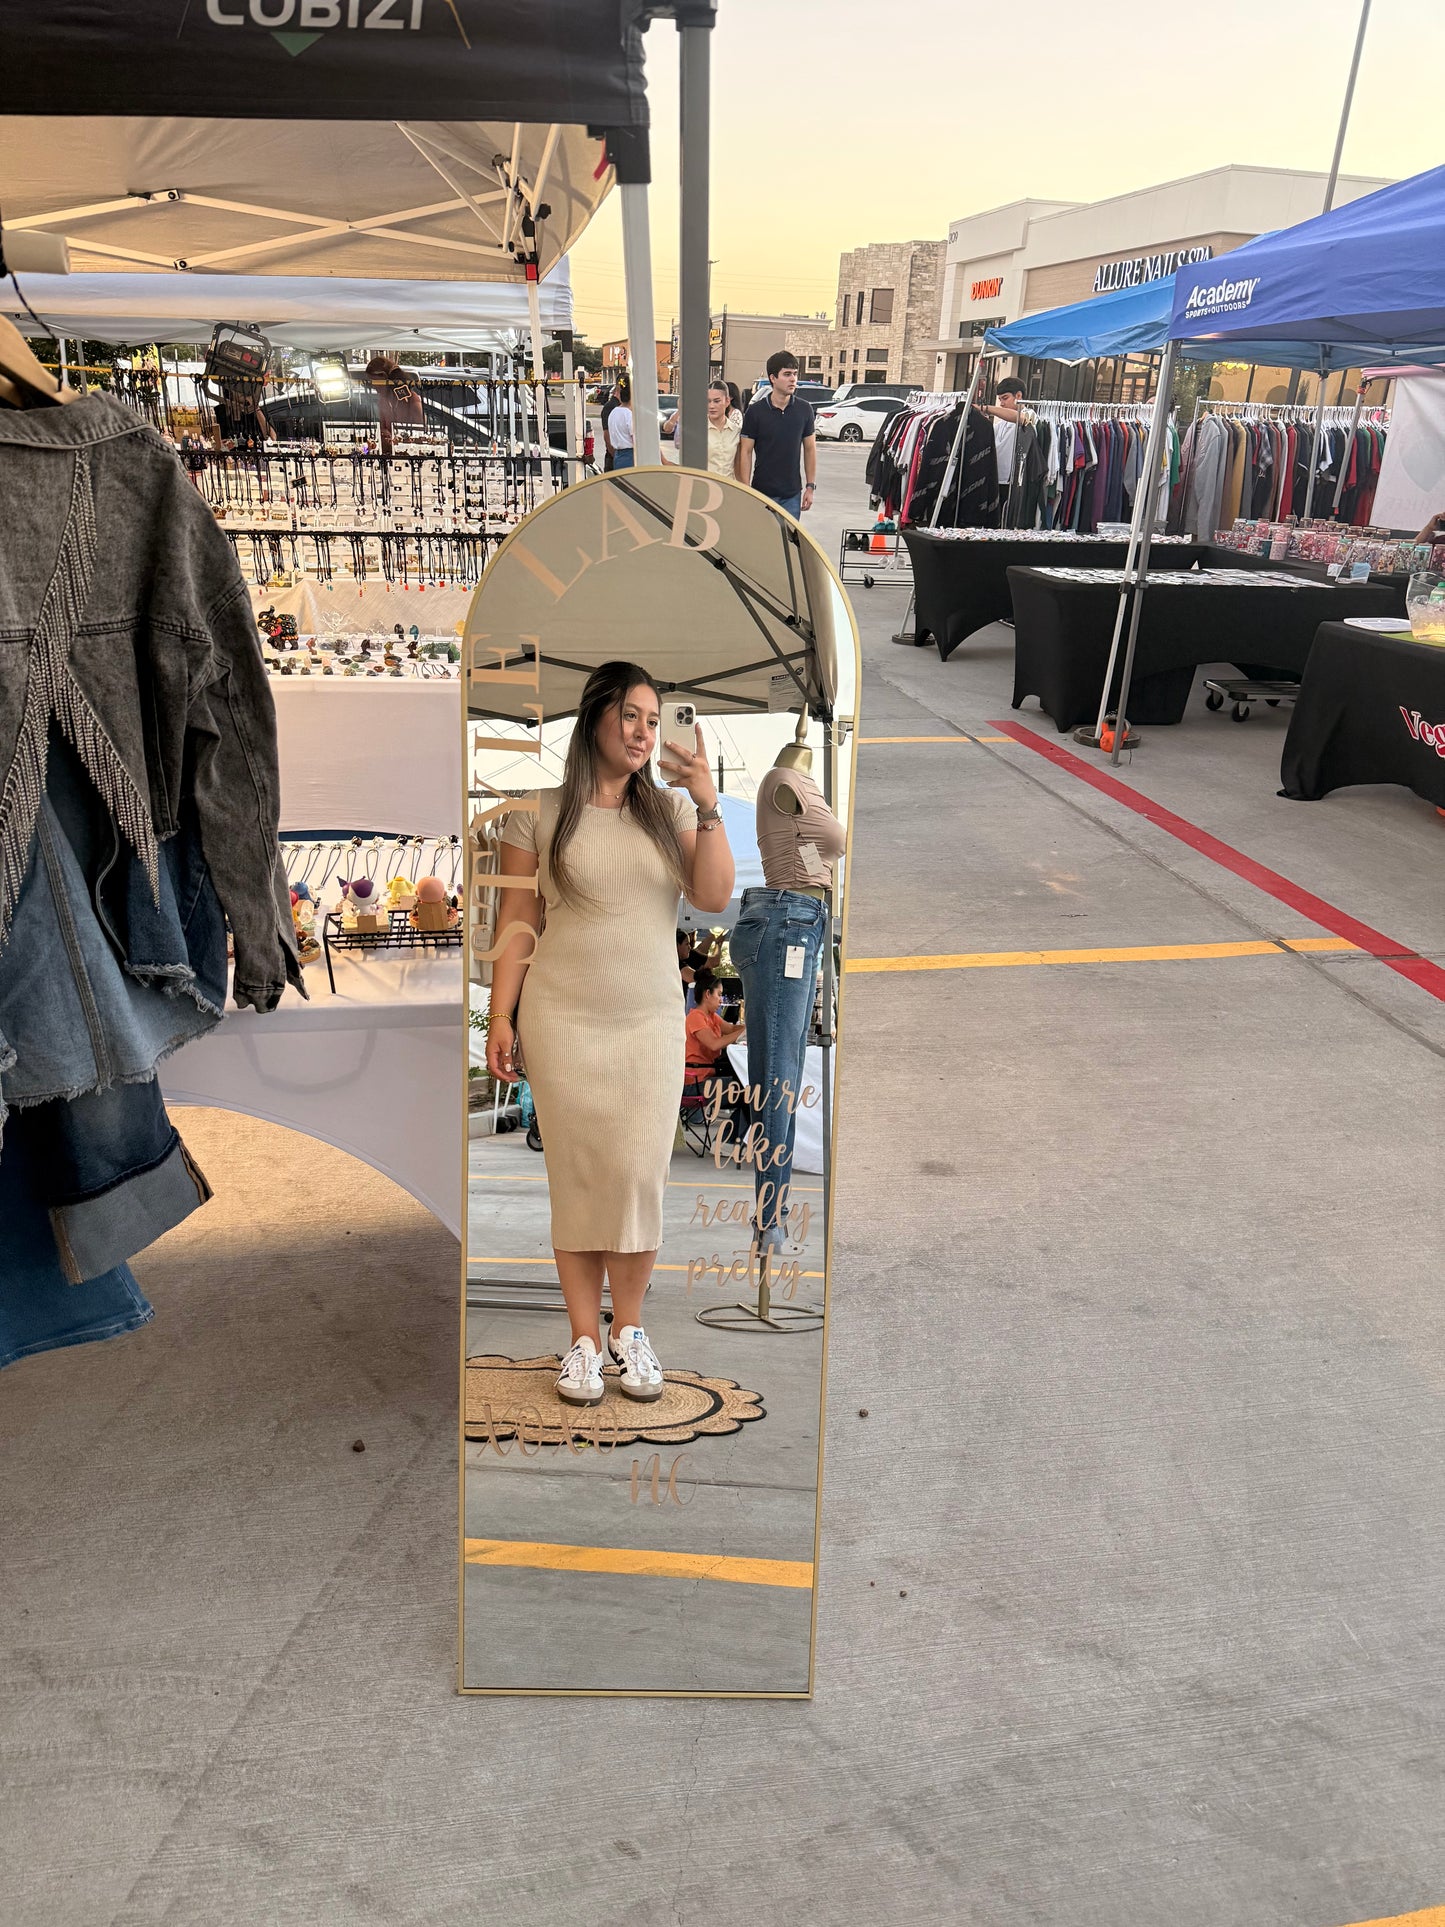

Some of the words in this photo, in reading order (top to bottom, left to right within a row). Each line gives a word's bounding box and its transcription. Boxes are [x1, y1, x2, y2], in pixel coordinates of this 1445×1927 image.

[1092, 258, 1142, 293] ALLURE
[1186, 278, 1258, 309] Academy
[1185, 300, 1247, 319] SPORTS+OUTDOORS
[506, 472, 725, 606] LAB
[470, 633, 544, 966] STYLE
[703, 1077, 822, 1122] you're
[714, 1119, 793, 1172] like
[690, 1181, 814, 1244] really
[687, 1240, 808, 1301] pretty
